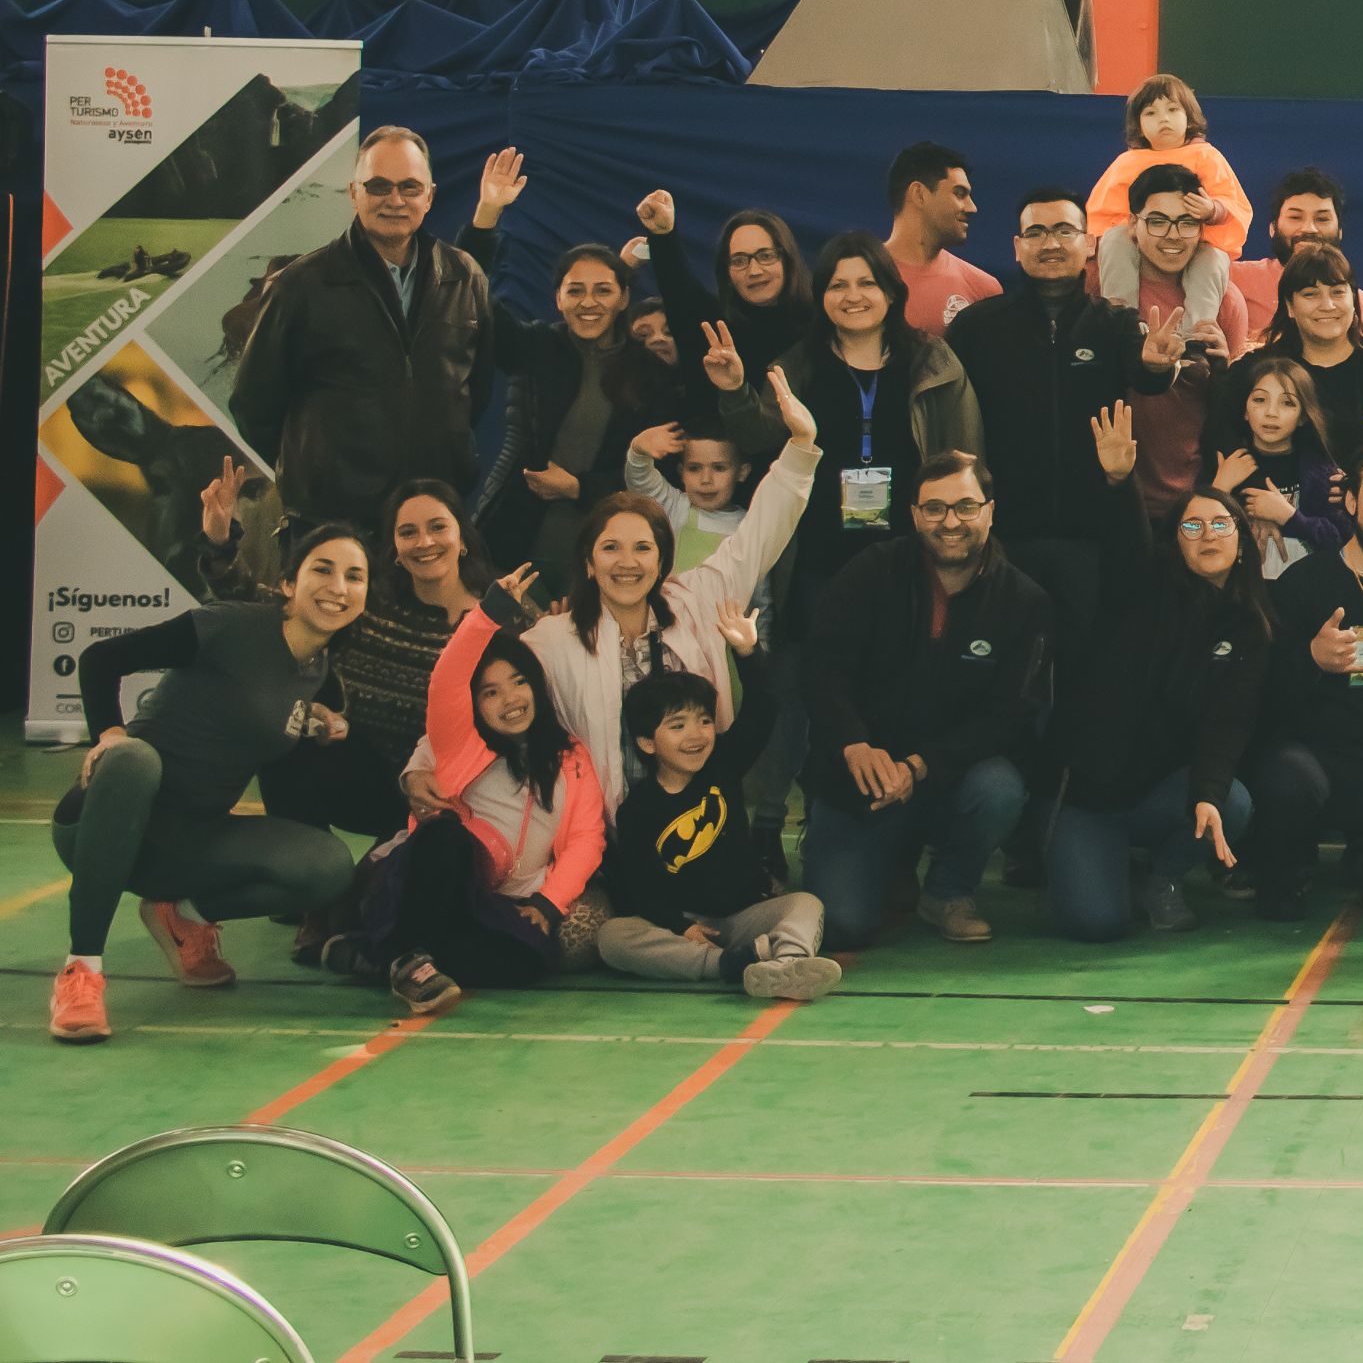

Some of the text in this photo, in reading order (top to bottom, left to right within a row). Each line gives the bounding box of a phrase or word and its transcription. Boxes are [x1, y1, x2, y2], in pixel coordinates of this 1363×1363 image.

[70, 96, 91, 106] PER
[70, 107, 119, 117] TURISMO
[44, 287, 152, 388] AVENTURA
[48, 586, 170, 612] ¡Síguenos!
